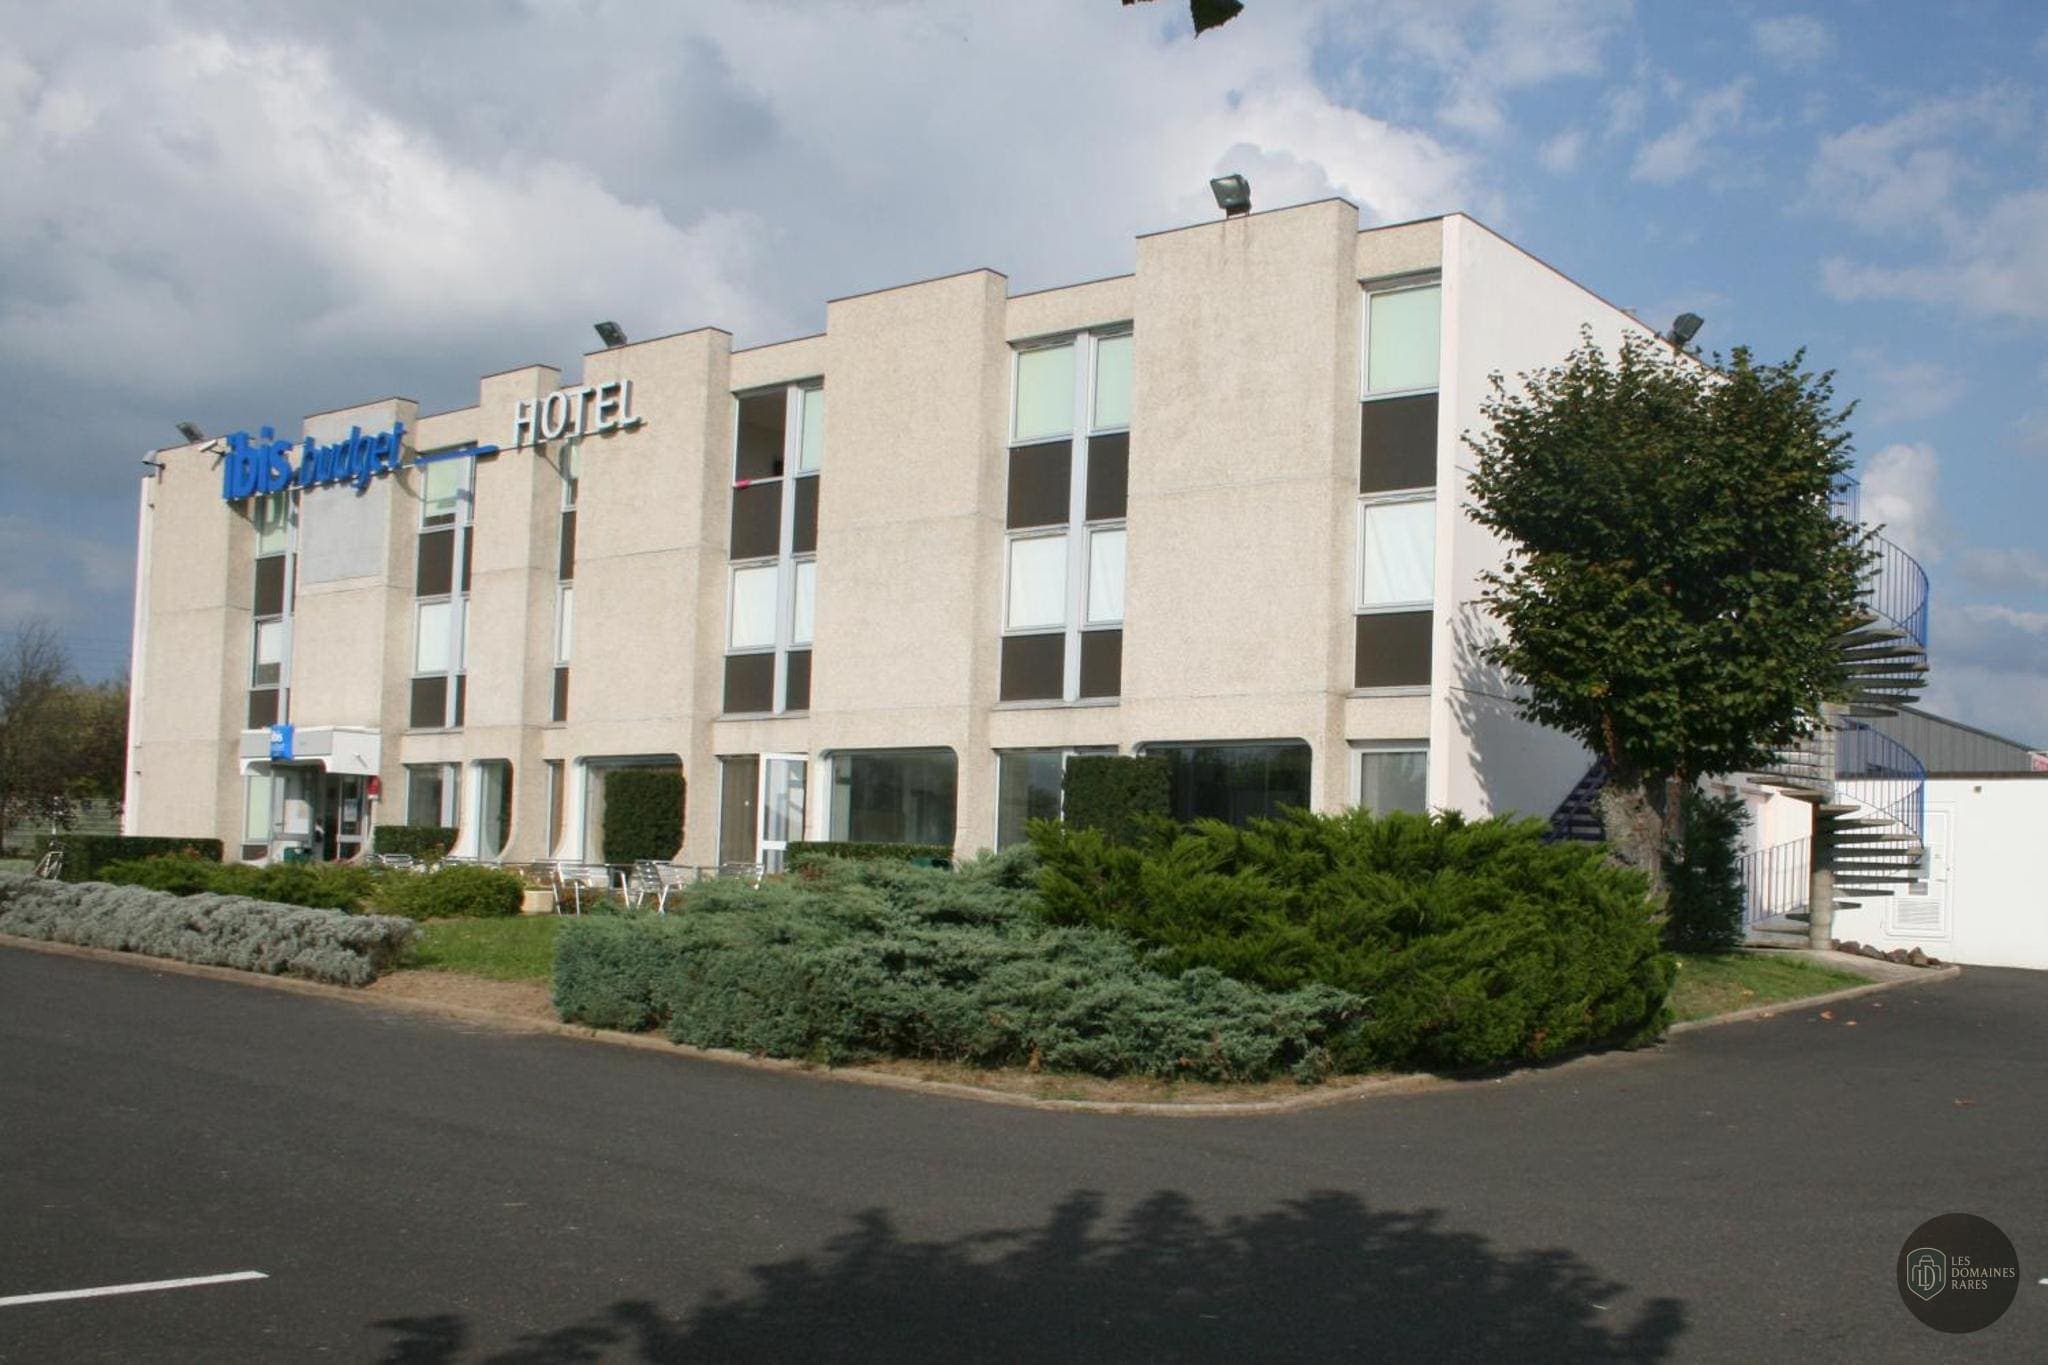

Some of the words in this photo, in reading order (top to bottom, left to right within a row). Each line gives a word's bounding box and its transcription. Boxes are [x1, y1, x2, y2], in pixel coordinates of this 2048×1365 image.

[514, 379, 642, 449] HOTEL
[222, 425, 293, 501] ibis
[298, 421, 408, 495] budget
